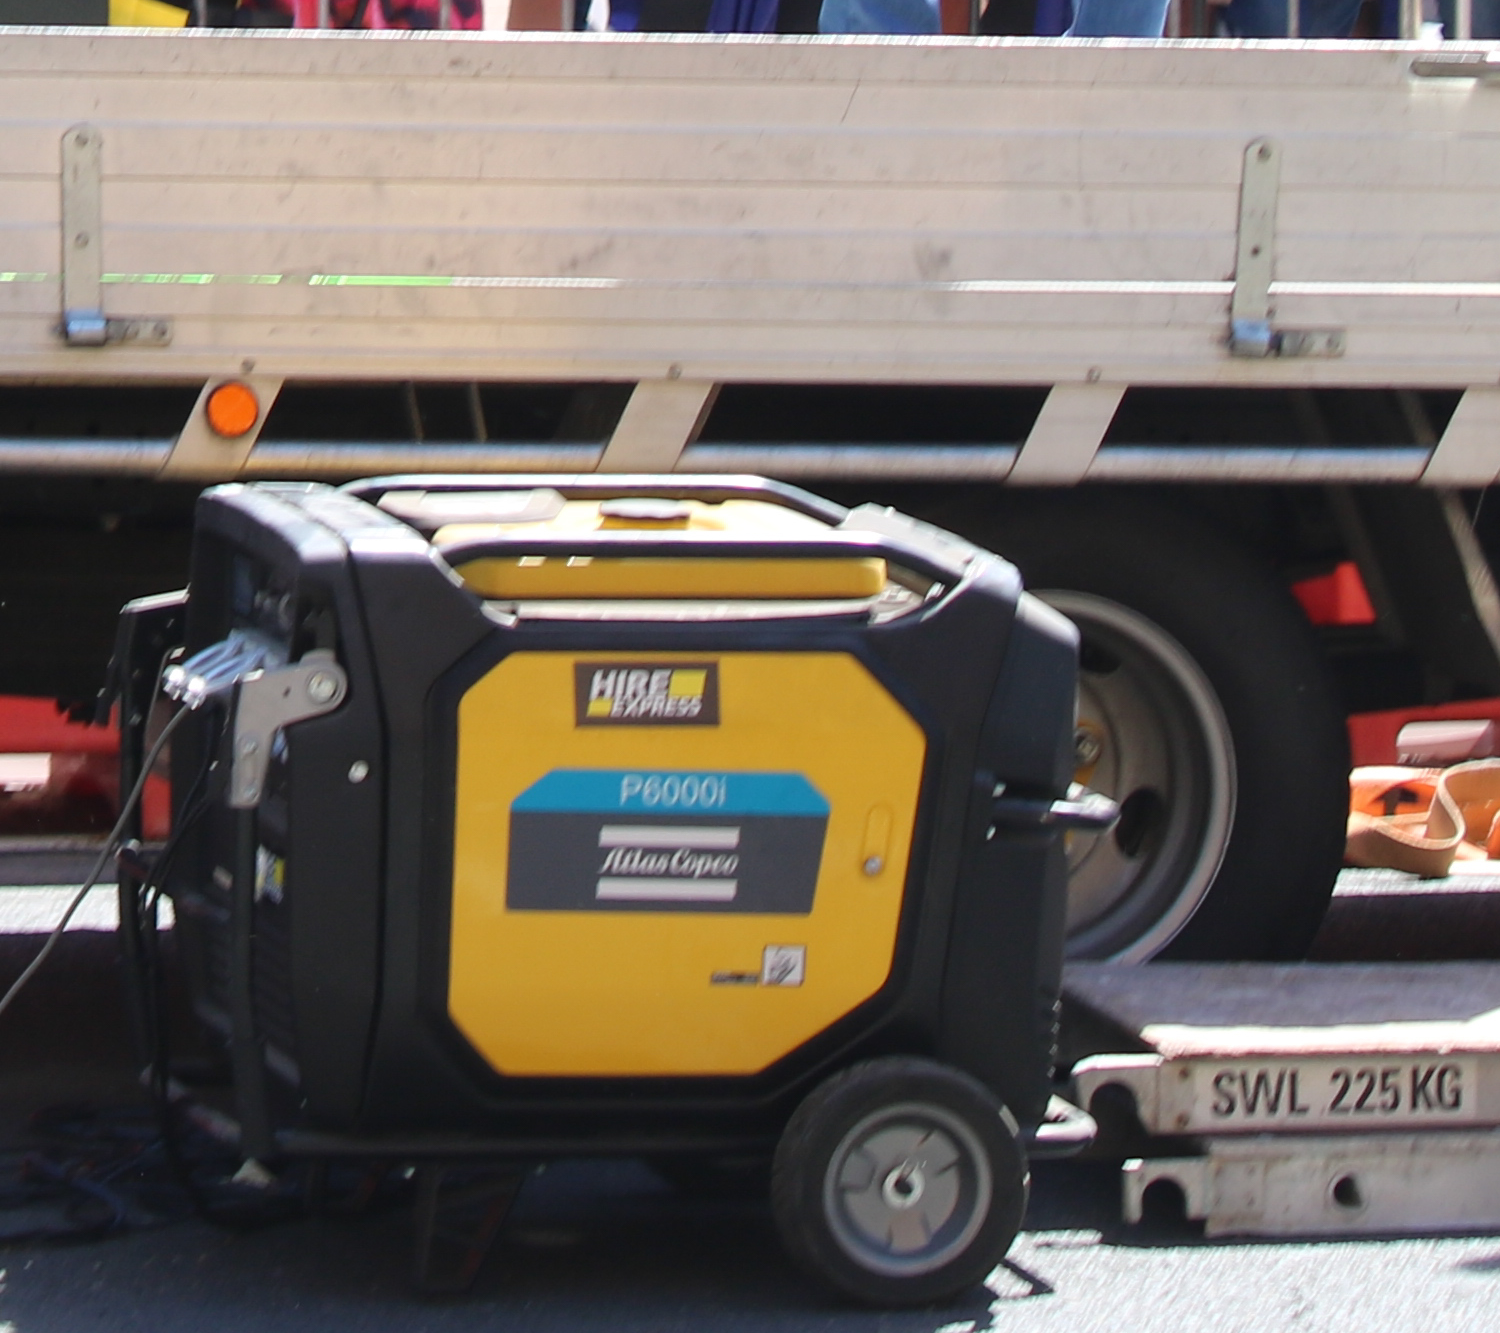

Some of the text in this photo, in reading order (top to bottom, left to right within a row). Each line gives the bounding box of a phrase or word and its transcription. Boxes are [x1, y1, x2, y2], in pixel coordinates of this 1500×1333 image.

[588, 668, 673, 701] HIRE
[610, 694, 703, 718] EXPRESS
[619, 773, 728, 808] P6000i
[597, 846, 740, 880] Atlas Copco
[1211, 1063, 1464, 1117] SWL 225 KG
